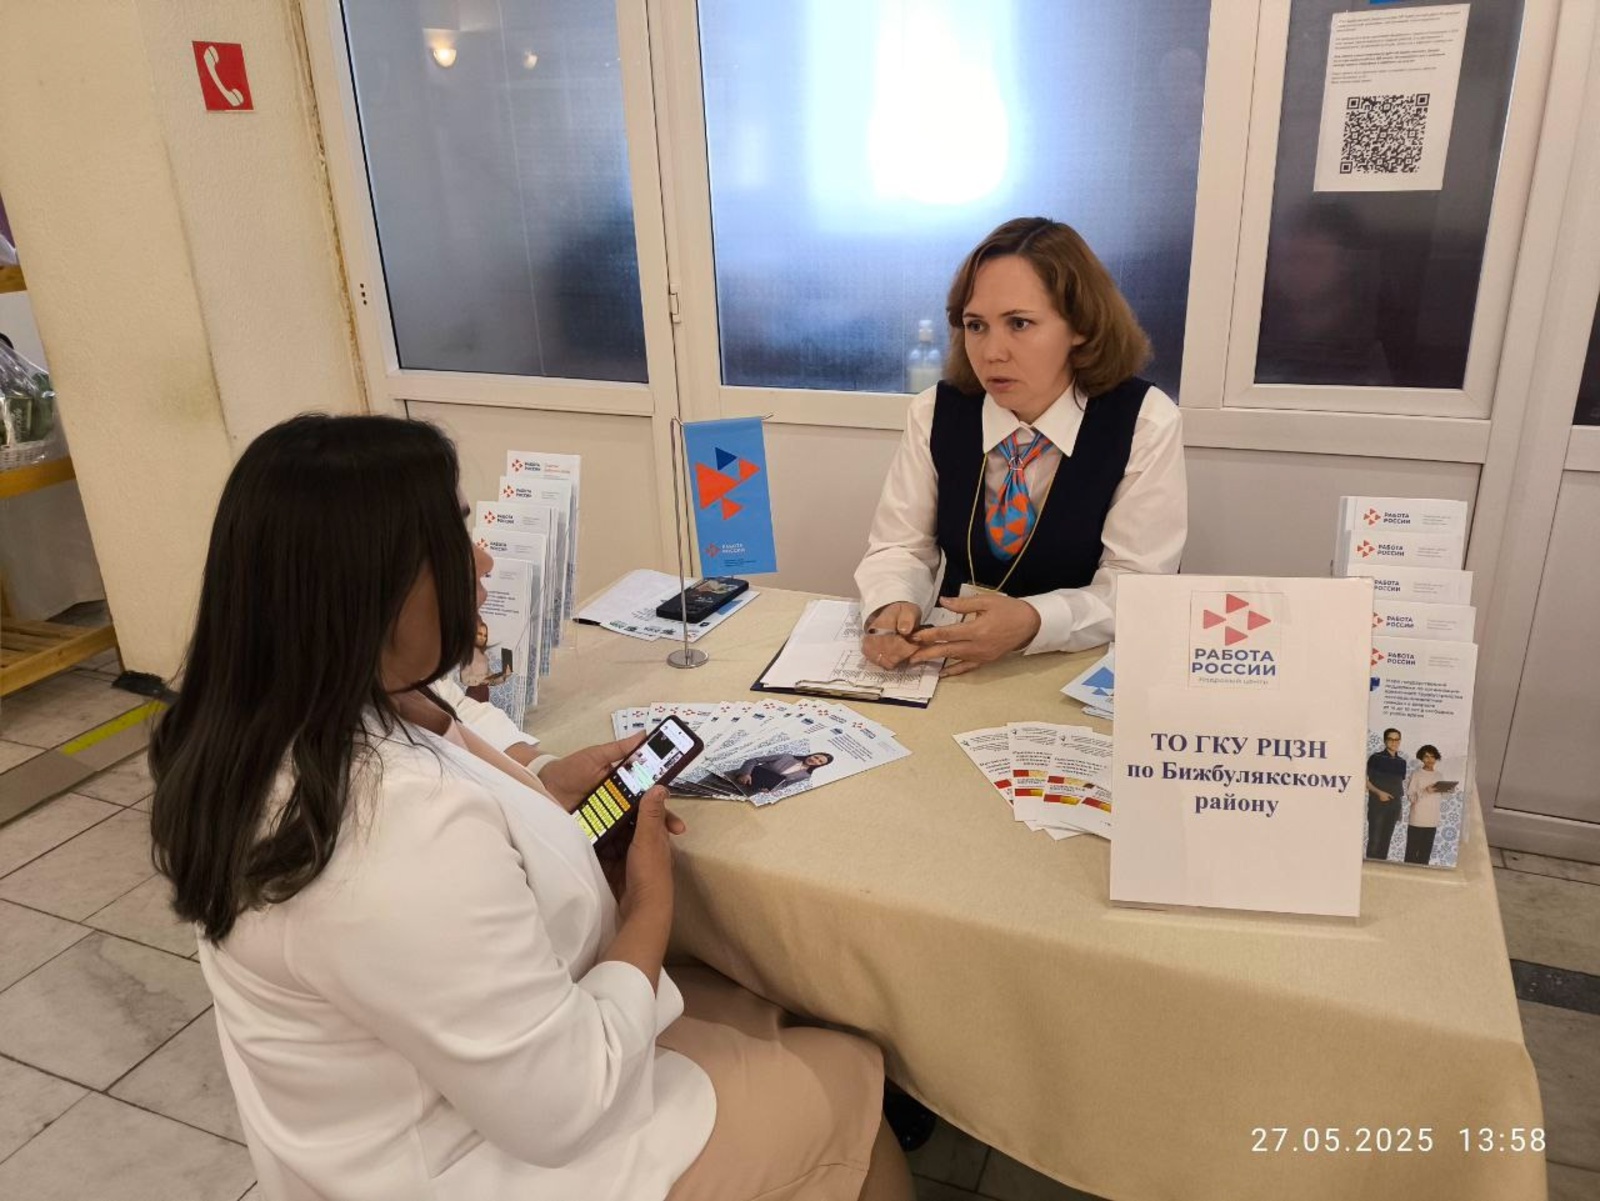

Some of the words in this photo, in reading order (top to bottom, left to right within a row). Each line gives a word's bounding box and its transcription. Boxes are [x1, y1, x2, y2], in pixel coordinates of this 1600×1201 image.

[1194, 648, 1274, 662] РАБОТА
[1387, 658, 1416, 666] РОССИИ
[1191, 662, 1276, 676] РОССИИ
[1150, 733, 1188, 752] ТО
[1195, 735, 1248, 755] ГКУ
[1256, 738, 1328, 762] РЦЗН
[1127, 764, 1154, 778] по
[1162, 761, 1352, 793] Бижбулякскому
[1195, 793, 1280, 818] району
